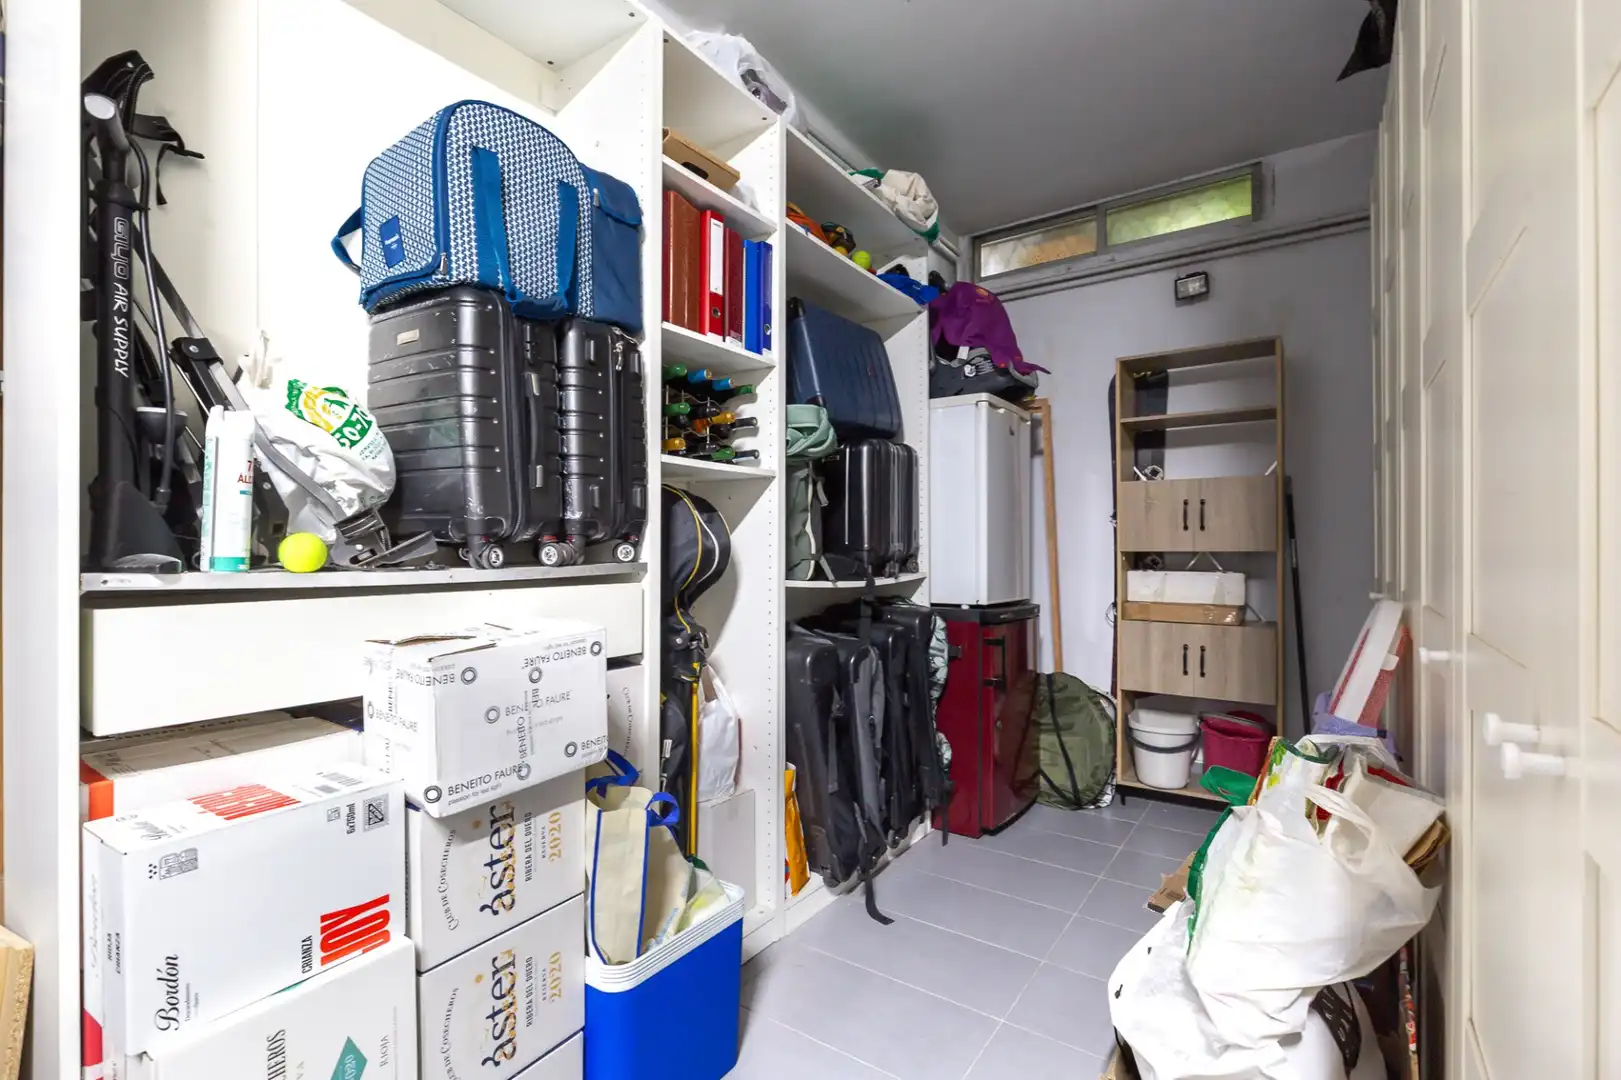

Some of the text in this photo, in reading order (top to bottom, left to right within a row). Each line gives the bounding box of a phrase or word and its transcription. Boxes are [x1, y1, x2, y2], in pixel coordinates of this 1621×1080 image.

[112, 283, 128, 311] AIR
[112, 316, 128, 378] SUPPLY
[448, 764, 522, 796] BENEITO FAURE
[525, 838, 533, 853] DEL
[549, 811, 561, 862] 2020
[438, 829, 460, 931] CLUB DE COSECHEROS
[525, 854, 533, 882] RIBERA
[301, 935, 312, 974] CRIANZA
[525, 956, 533, 982] DUERO
[155, 954, 180, 1031] Bordón
[549, 951, 561, 1003] 2020
[267, 1029, 286, 1080] HEROS
[380, 1034, 390, 1067] RIOJA
